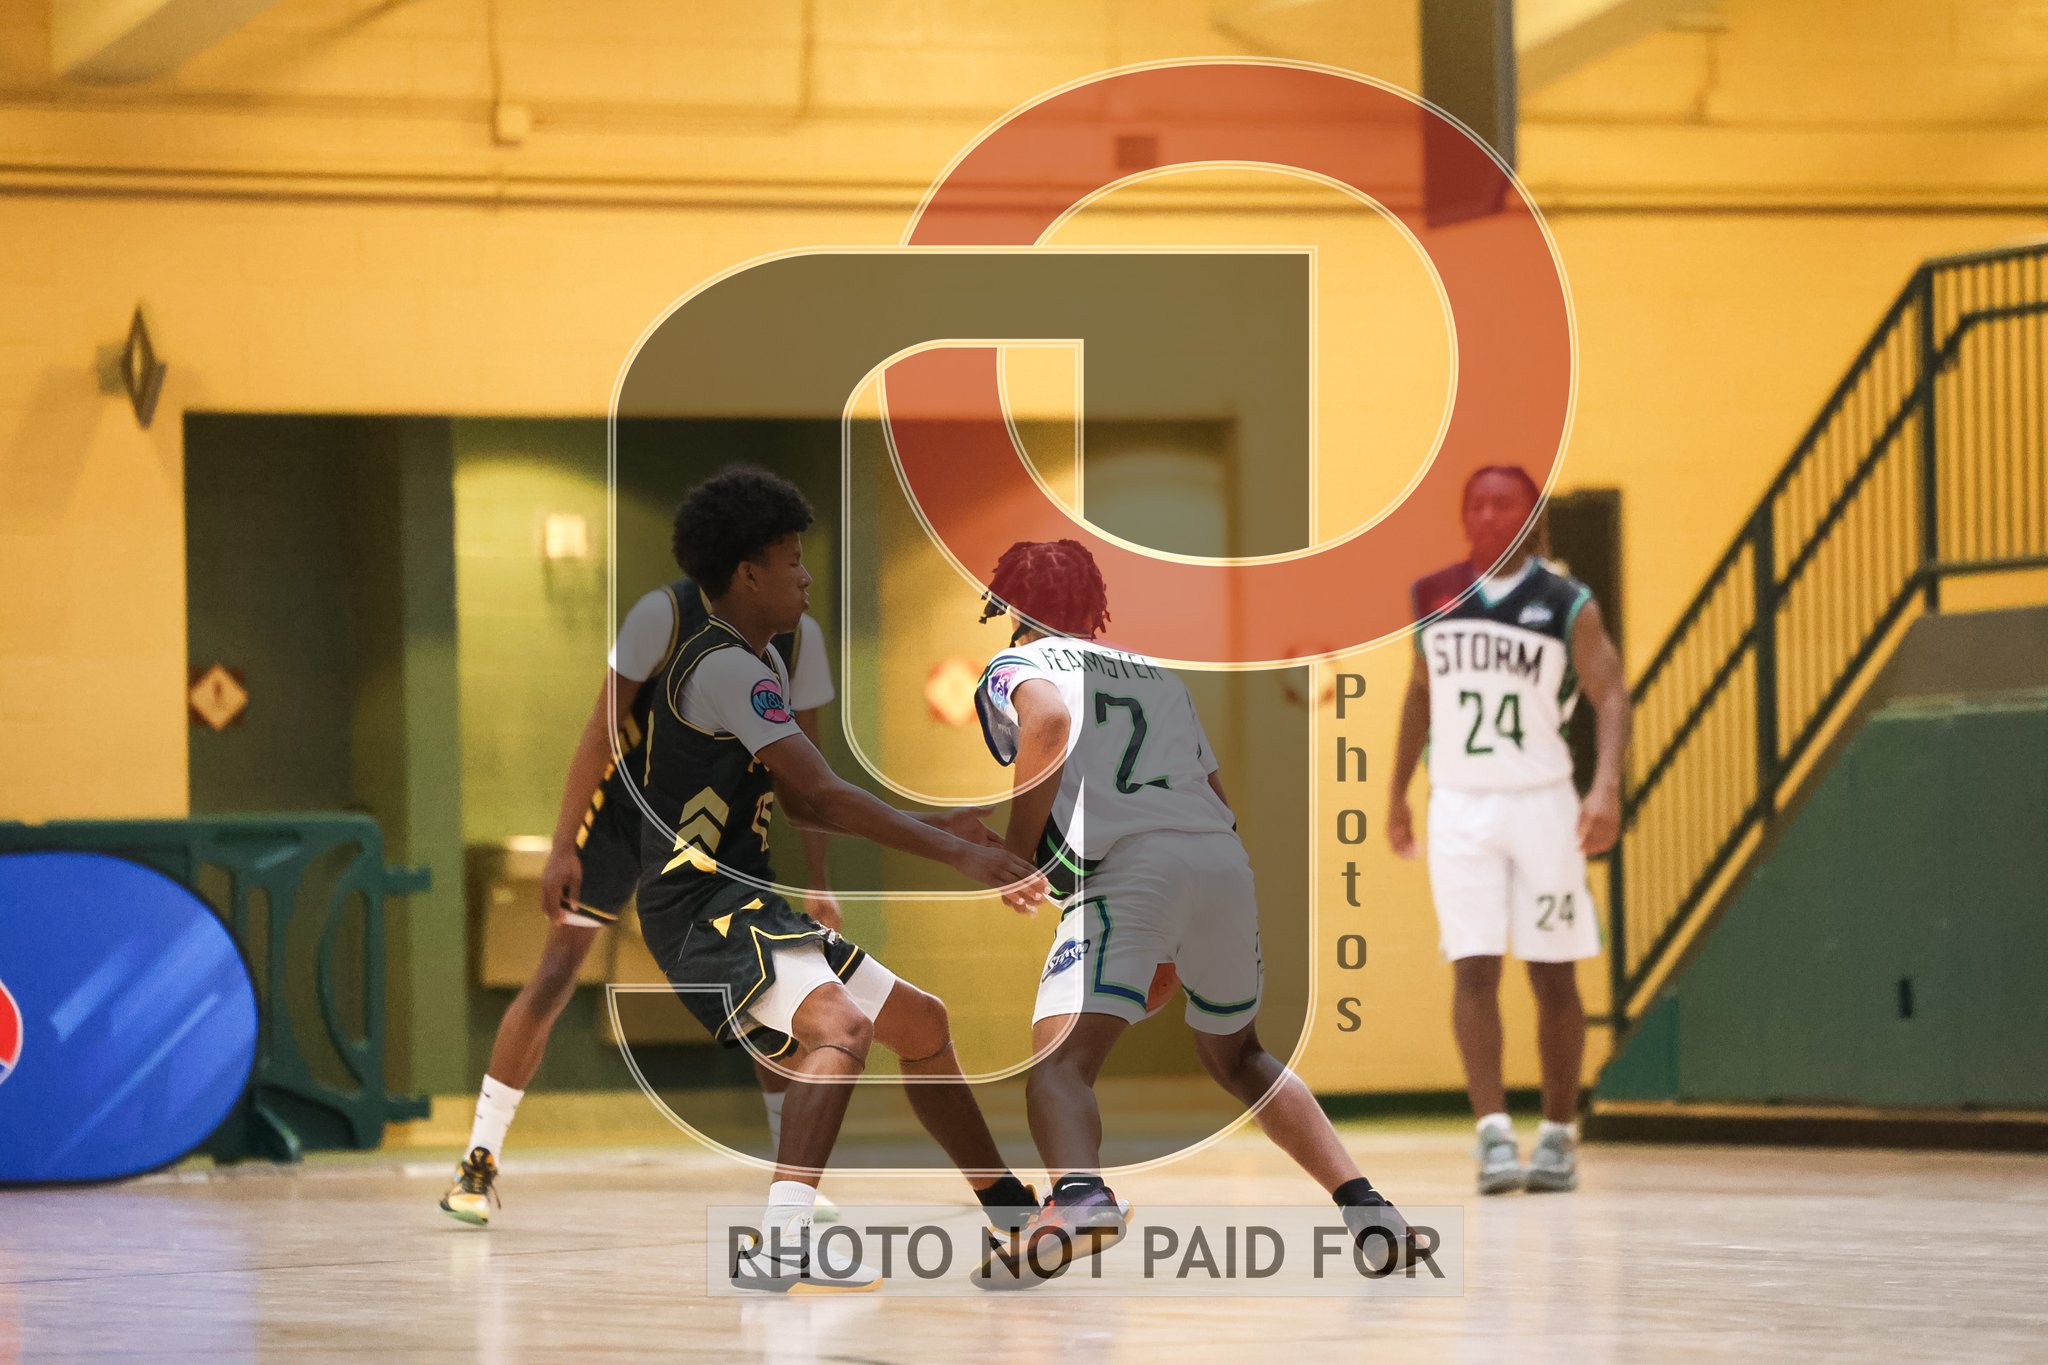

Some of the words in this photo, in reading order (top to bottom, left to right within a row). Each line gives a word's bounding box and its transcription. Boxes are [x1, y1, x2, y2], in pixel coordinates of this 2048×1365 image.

[1432, 631, 1544, 685] STORM
[1094, 691, 1172, 795] 2
[1459, 690, 1525, 754] 24
[1535, 893, 1576, 932] 24
